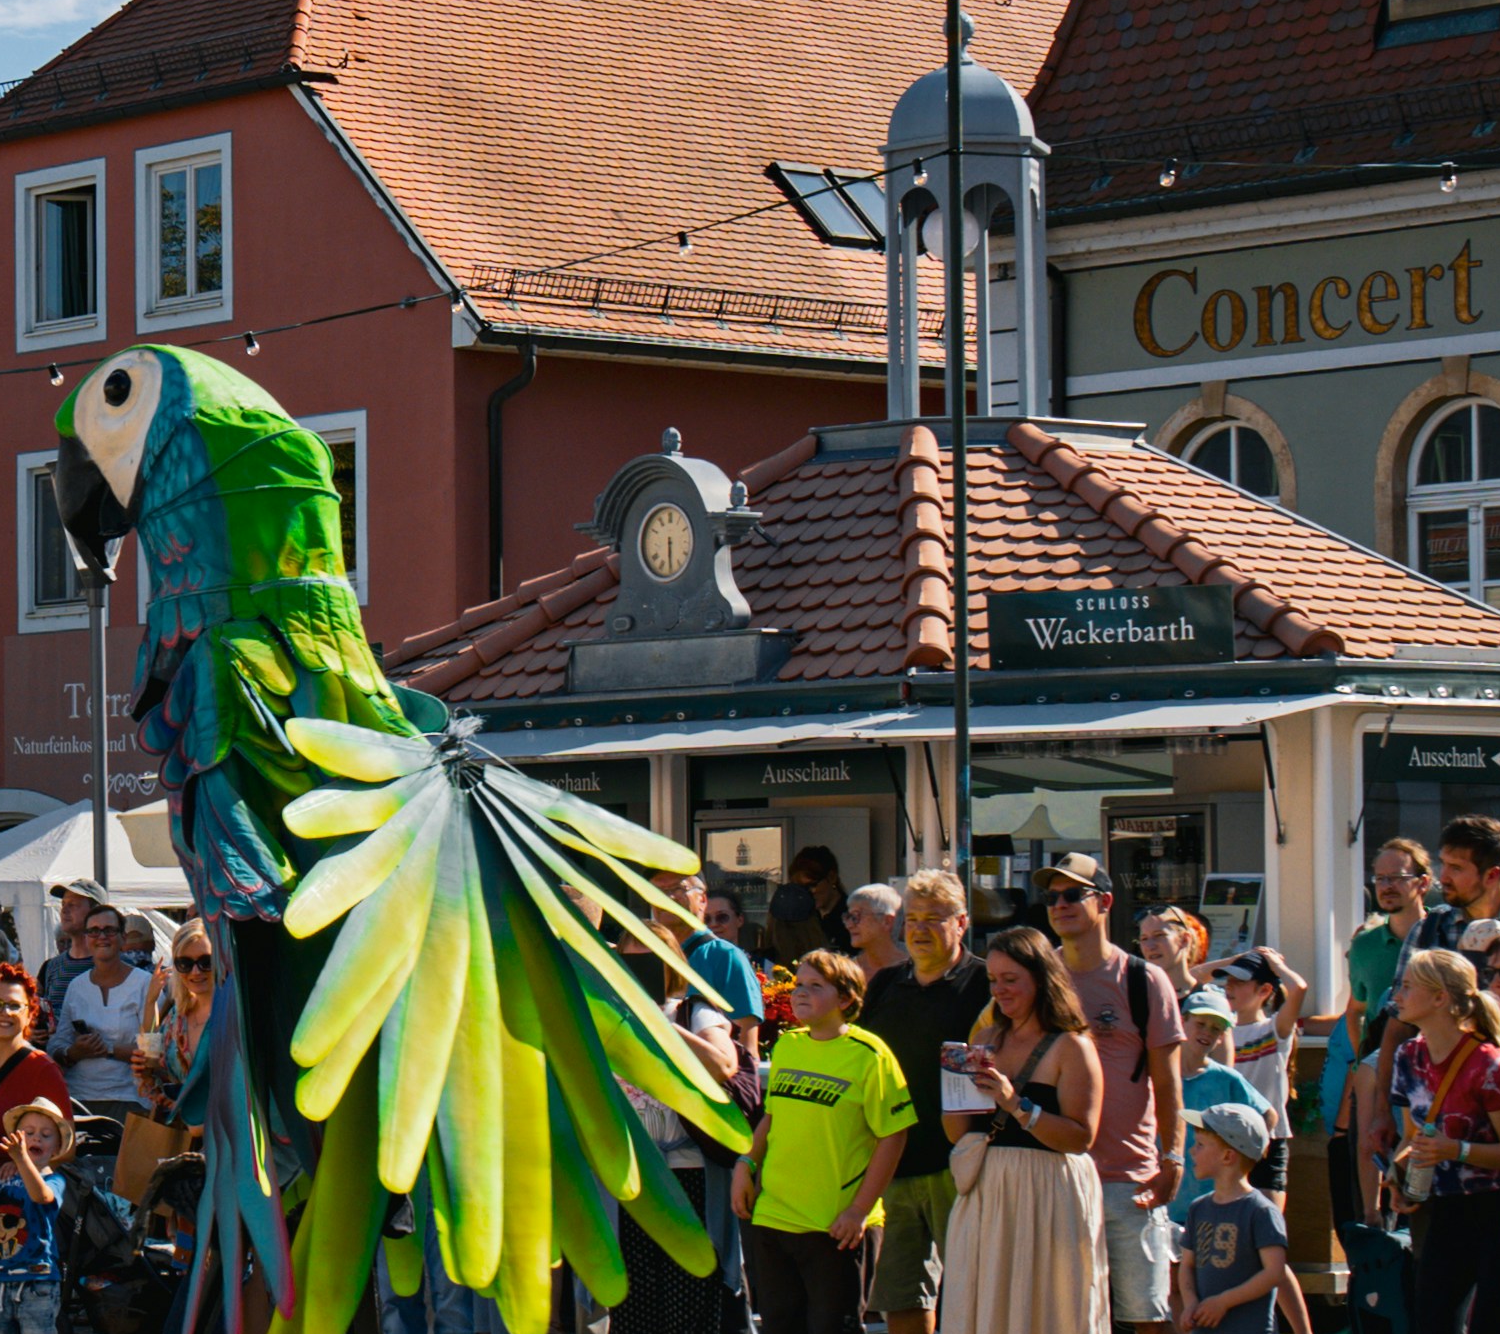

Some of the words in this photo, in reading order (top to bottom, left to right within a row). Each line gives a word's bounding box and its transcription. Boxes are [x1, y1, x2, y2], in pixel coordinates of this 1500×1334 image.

[1133, 238, 1484, 358] Concert
[1076, 595, 1151, 611] SCHLOSS
[1025, 616, 1196, 651] Wackerbarth
[13, 734, 93, 755] Naturfeinkos
[1408, 745, 1487, 768] Ausschank
[761, 760, 851, 785] Ausschank
